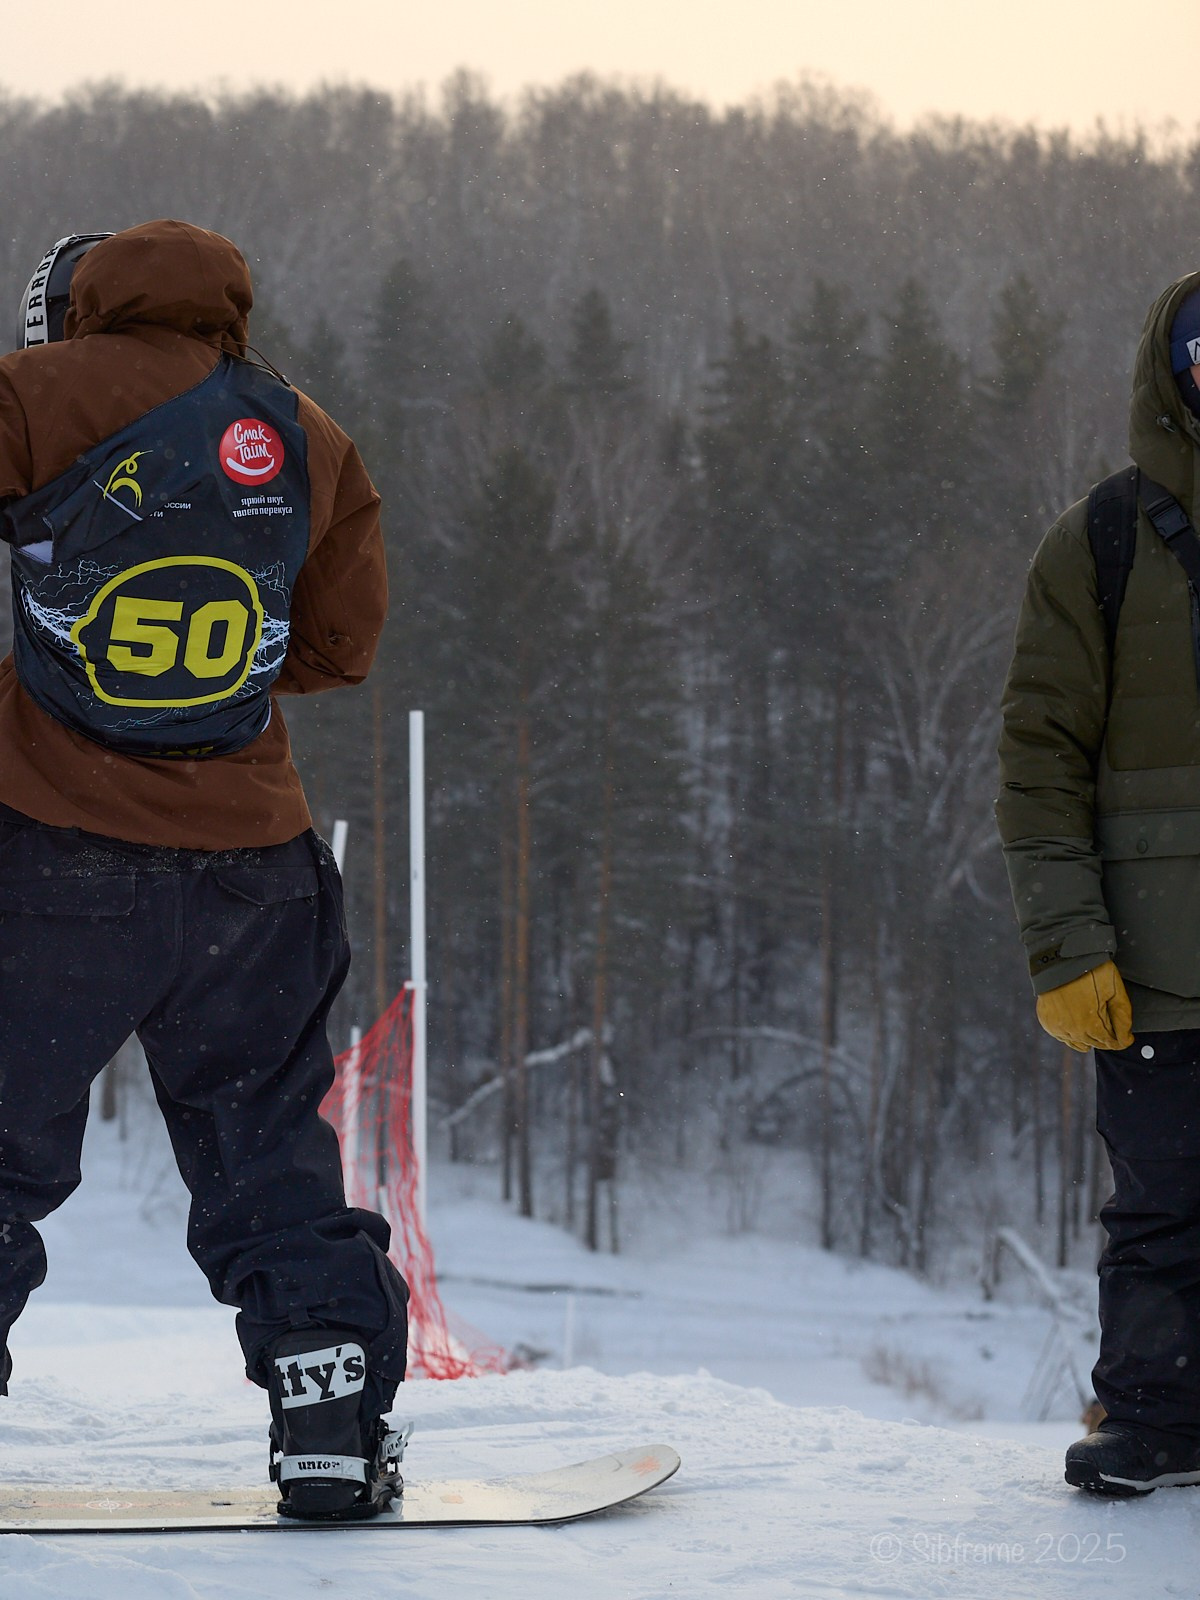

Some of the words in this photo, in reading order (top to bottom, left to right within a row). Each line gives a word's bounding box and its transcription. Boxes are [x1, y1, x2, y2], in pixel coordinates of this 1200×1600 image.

[233, 422, 272, 443] Смак
[234, 442, 273, 464] Тайм
[266, 496, 285, 506] вкус
[106, 595, 249, 679] 50
